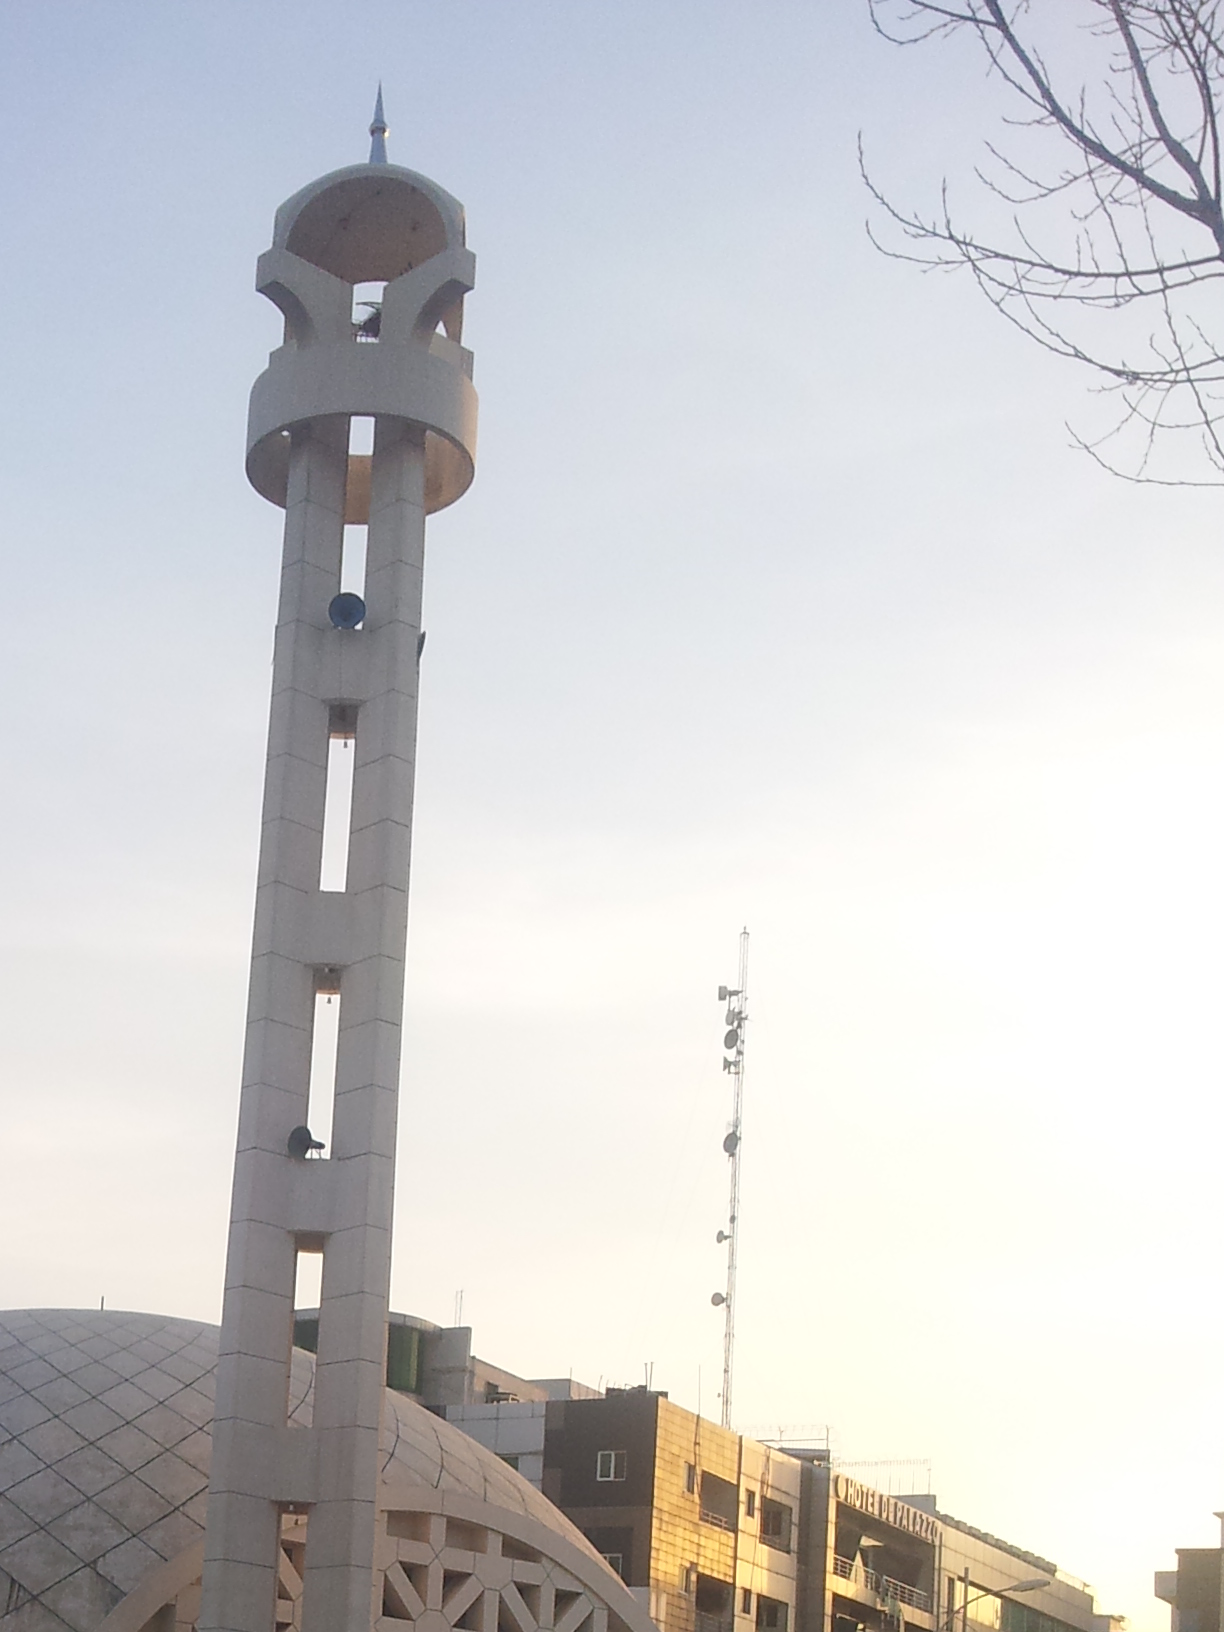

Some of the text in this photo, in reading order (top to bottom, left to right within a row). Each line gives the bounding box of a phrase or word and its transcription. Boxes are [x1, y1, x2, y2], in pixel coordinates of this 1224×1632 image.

[847, 1478, 940, 1545] HOTEL DE PALAZZO
